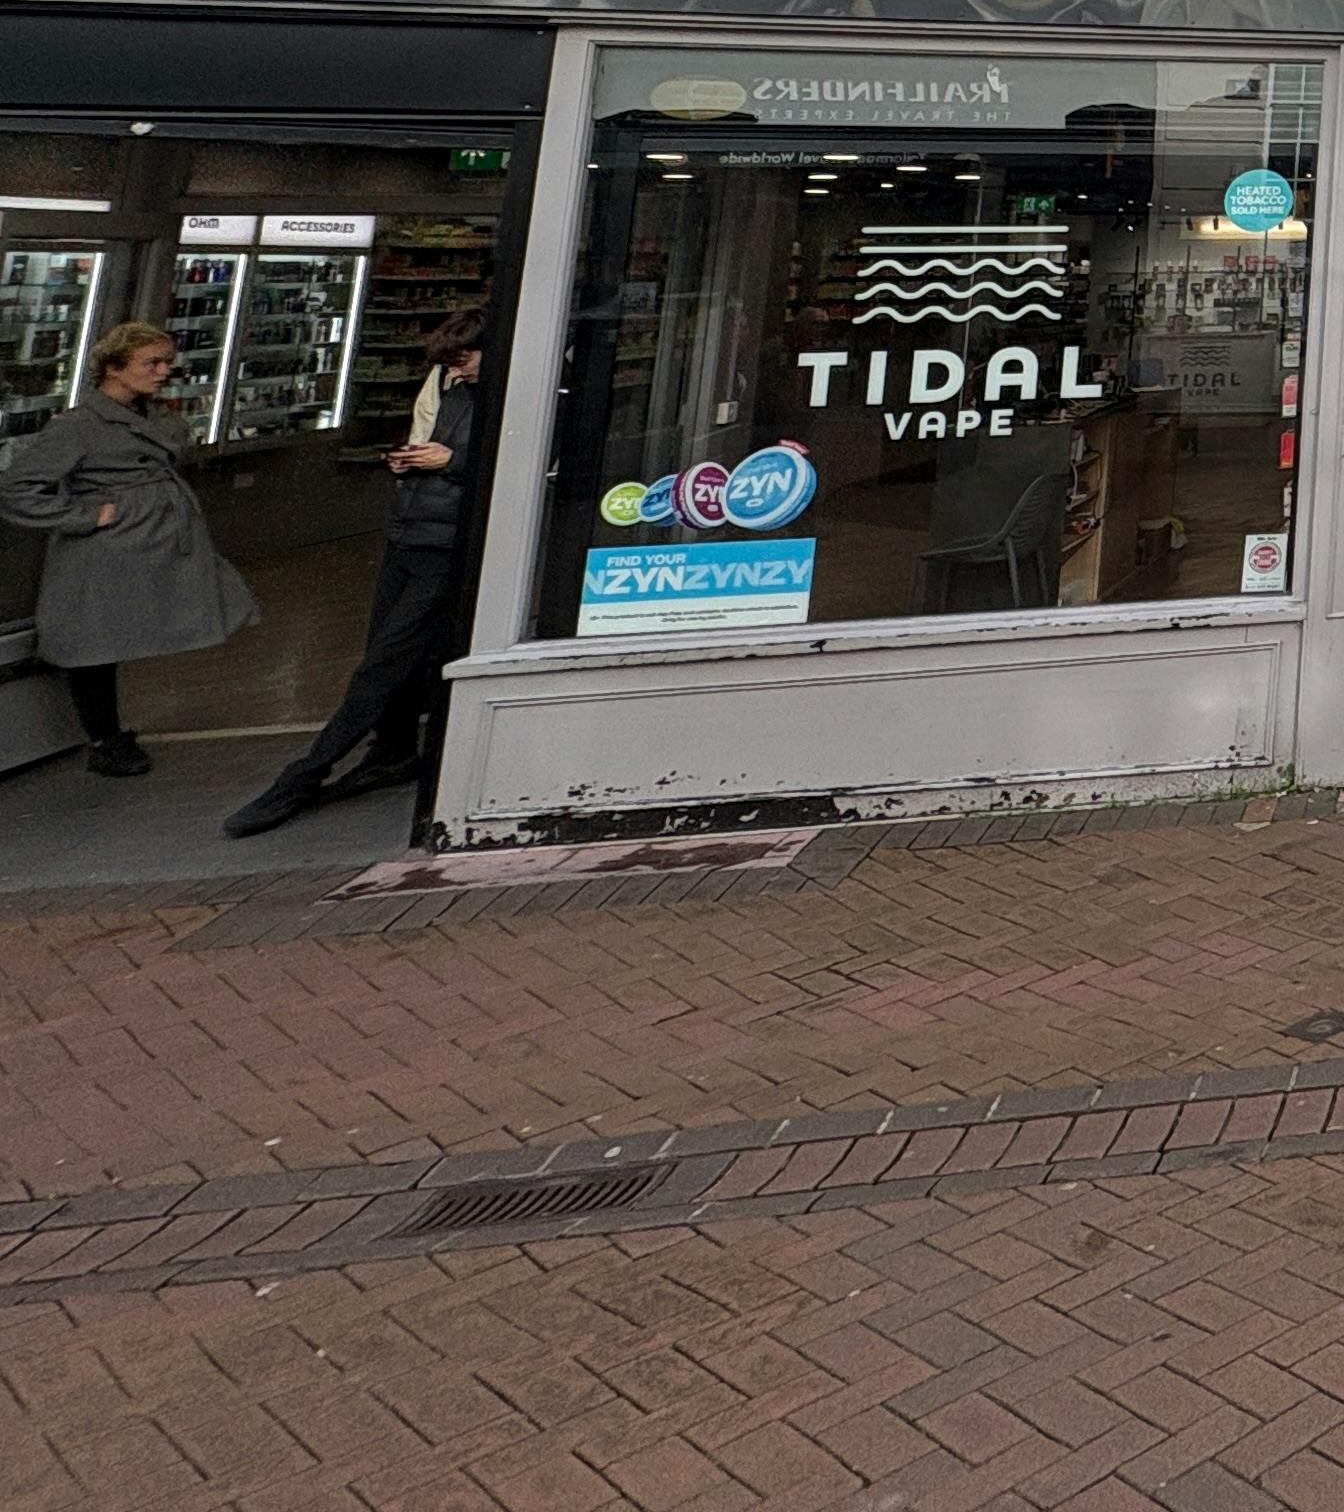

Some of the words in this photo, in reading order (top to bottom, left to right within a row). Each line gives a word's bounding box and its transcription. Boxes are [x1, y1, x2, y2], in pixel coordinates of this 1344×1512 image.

[1236, 185, 1282, 196] HEATED
[1230, 195, 1287, 205] TOBACCO
[1230, 206, 1258, 216] SOLD
[1259, 205, 1285, 215] HERE
[280, 220, 356, 235] ACCESSORIES
[797, 345, 1104, 408] TIDAL
[1167, 372, 1242, 388] TIDAL
[1187, 387, 1220, 397] VAPE
[883, 408, 1015, 441] VAPE
[729, 468, 793, 501] ZYN
[607, 555, 642, 568] FIND
[645, 553, 688, 566] YOUR
